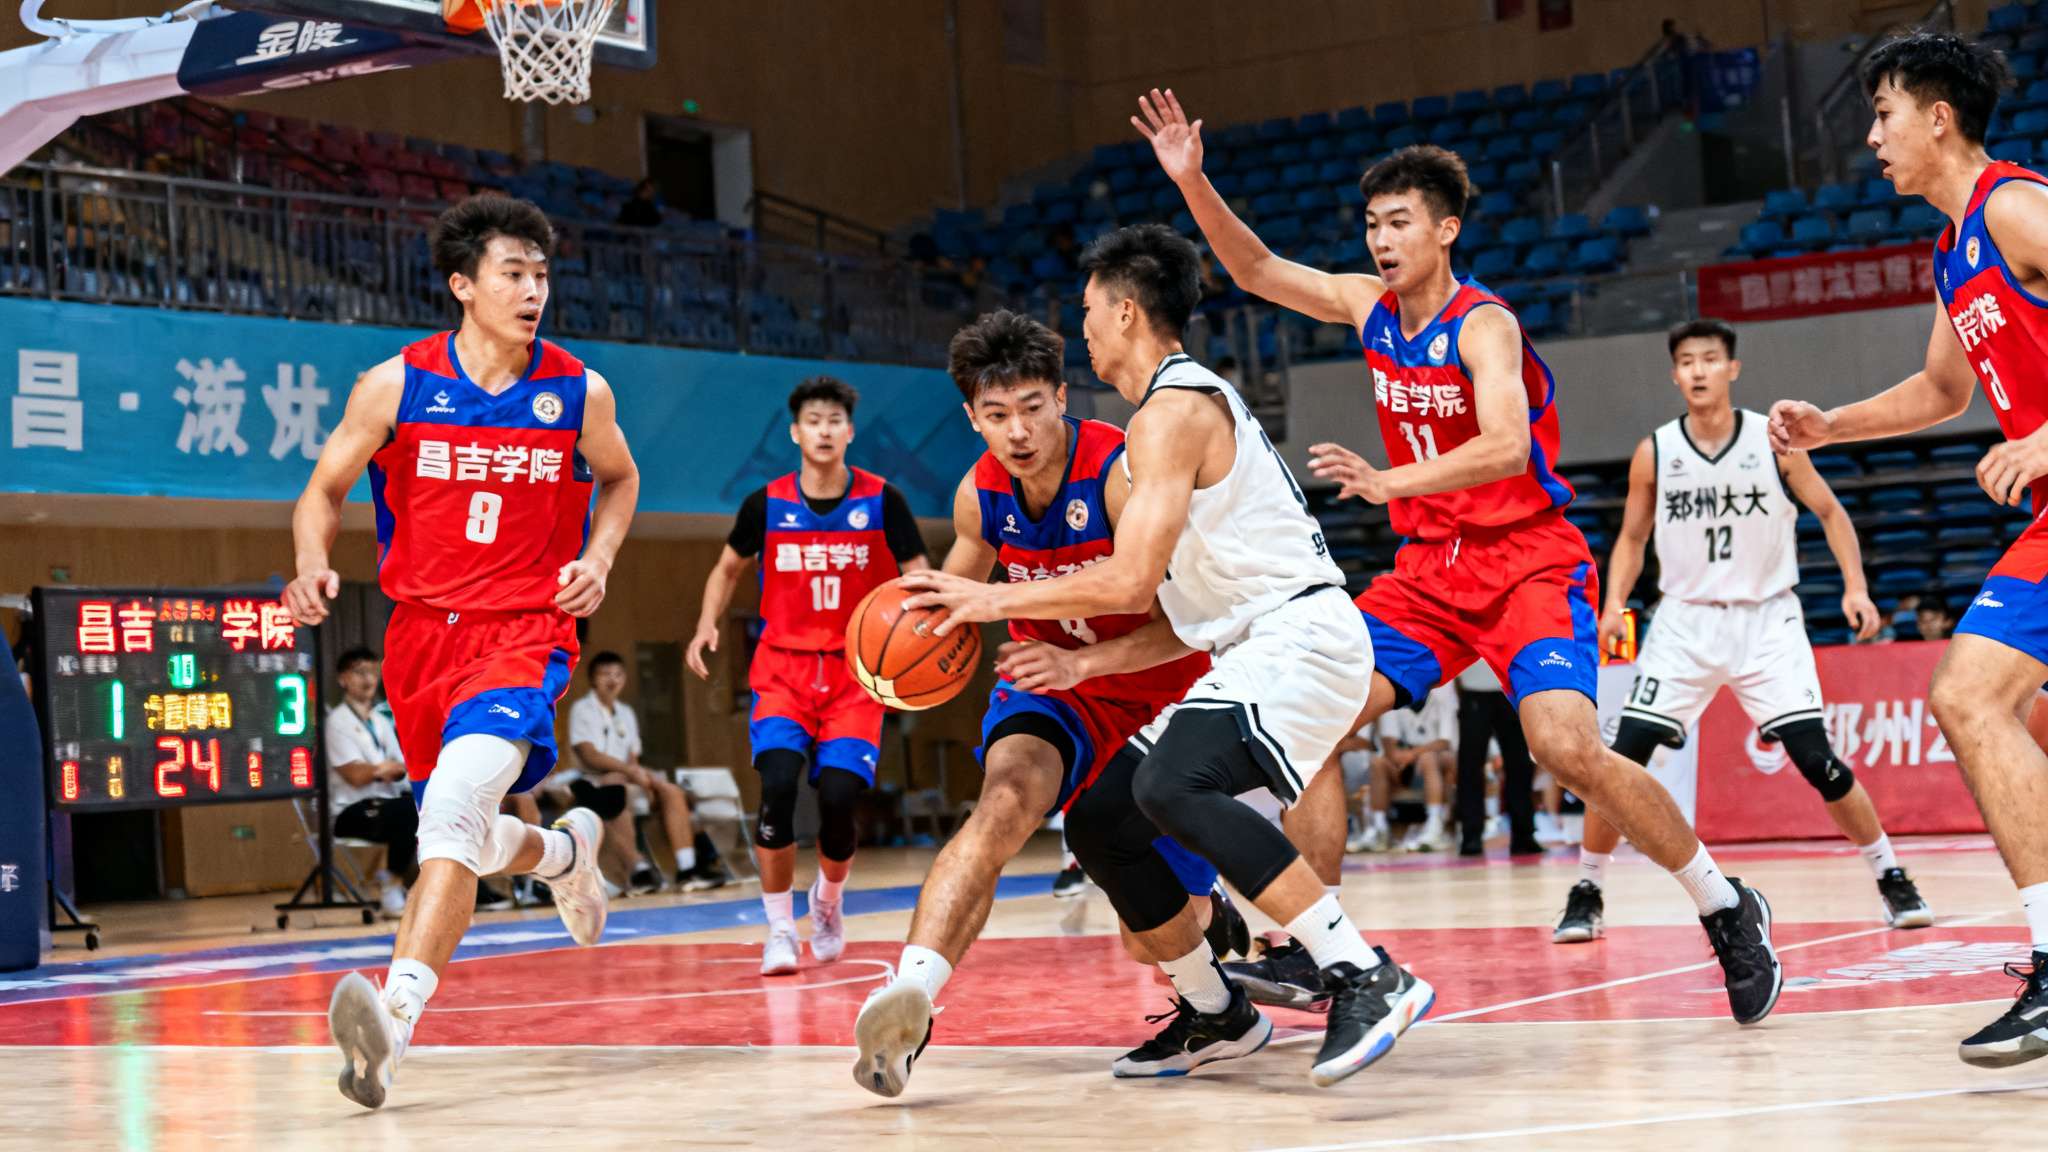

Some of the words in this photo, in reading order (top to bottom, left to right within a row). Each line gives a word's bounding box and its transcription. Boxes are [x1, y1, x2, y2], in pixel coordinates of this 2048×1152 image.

[416, 439, 564, 484] 昌吉学院
[465, 491, 503, 544] 8
[1705, 525, 1732, 563] 12
[810, 576, 841, 611] 10
[155, 736, 220, 797] 24
